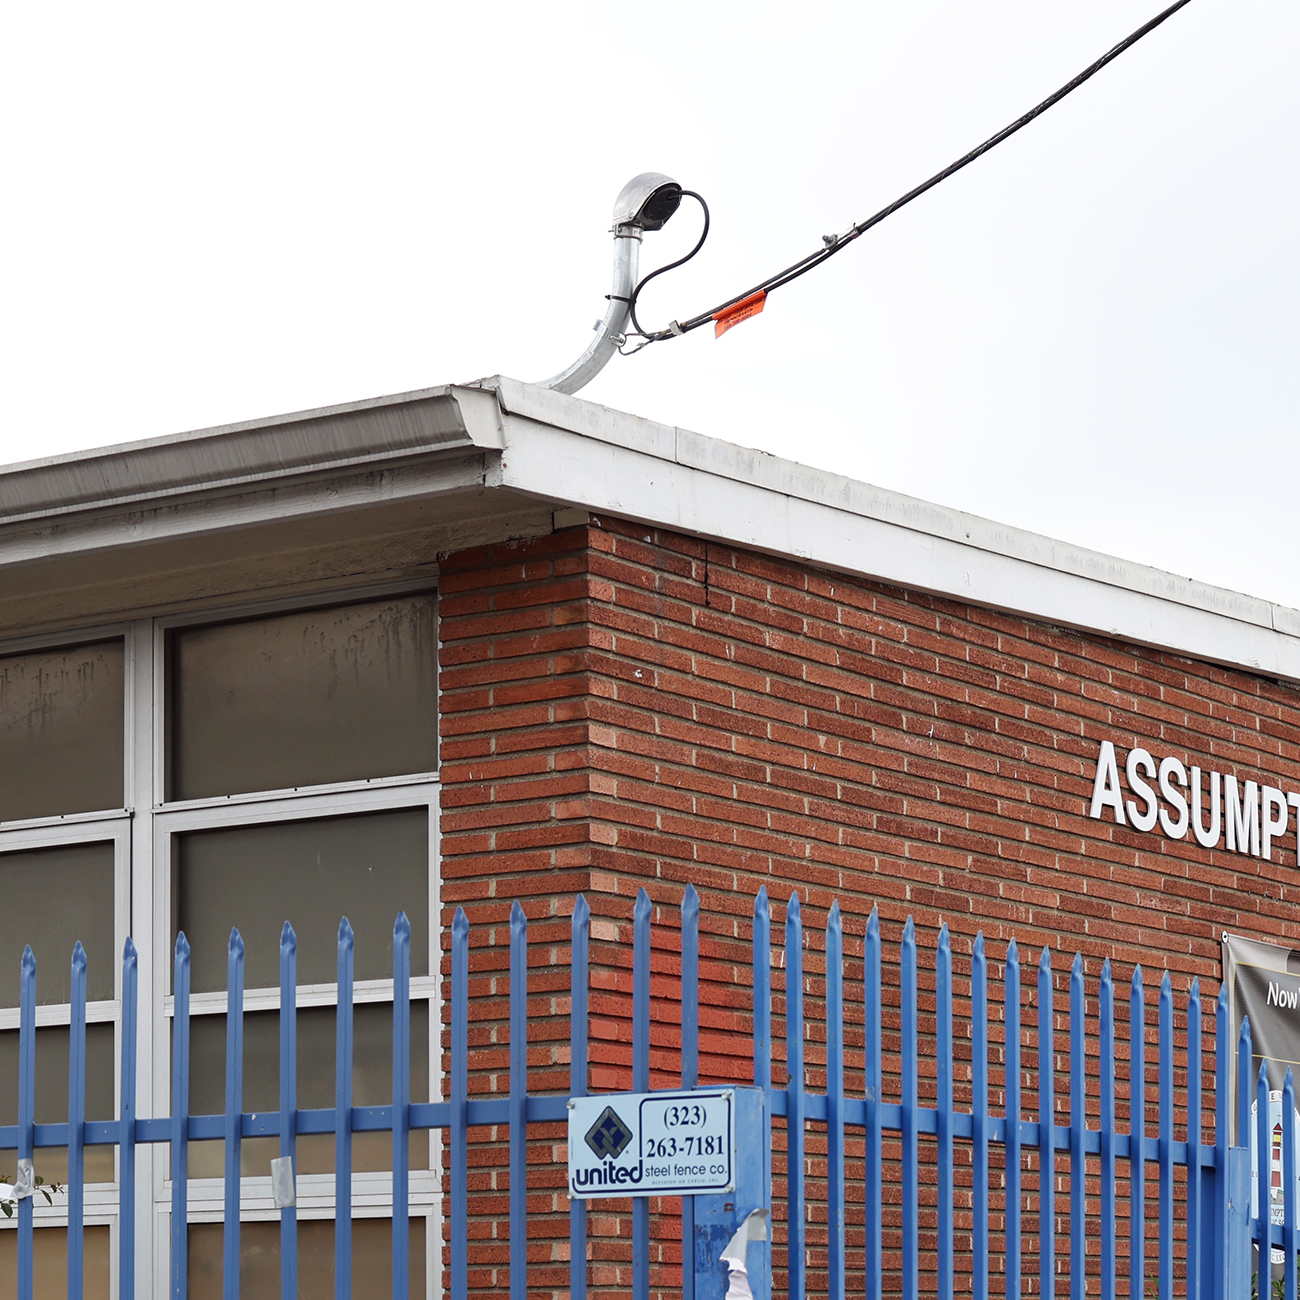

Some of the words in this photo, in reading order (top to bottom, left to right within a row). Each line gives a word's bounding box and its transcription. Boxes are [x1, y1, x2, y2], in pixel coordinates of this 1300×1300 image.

[1266, 981, 1298, 1010] Now
[663, 1105, 707, 1130] (323)
[646, 1135, 724, 1158] 263-7181
[575, 1159, 643, 1186] united
[645, 1164, 671, 1177] steel
[674, 1163, 706, 1176] fence
[709, 1164, 727, 1175] co.
